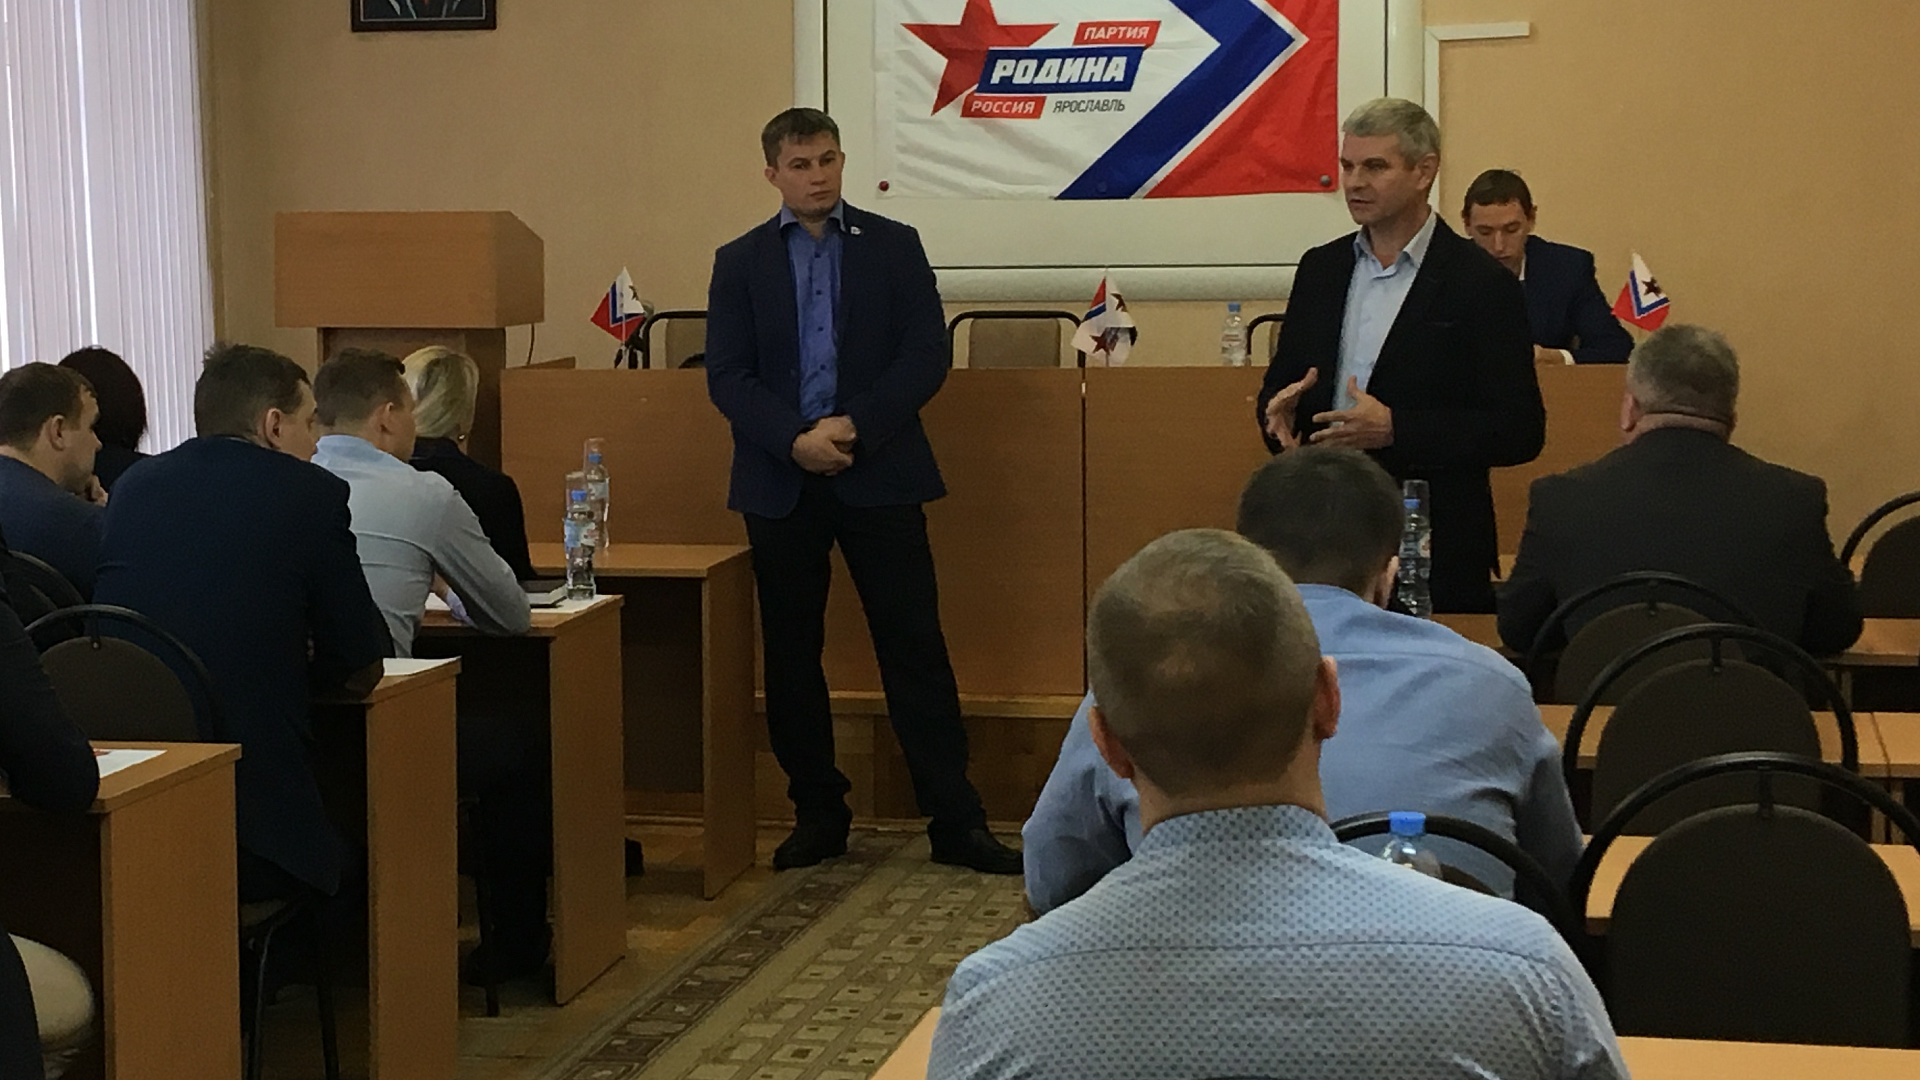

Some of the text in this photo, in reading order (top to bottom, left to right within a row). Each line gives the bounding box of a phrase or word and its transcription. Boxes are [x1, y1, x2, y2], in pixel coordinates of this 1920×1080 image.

[1083, 26, 1150, 40] ПАРТИЯ
[989, 56, 1128, 85] РОДИНА
[970, 101, 1036, 114] РОССИЯ
[1052, 99, 1126, 114] ЯРОСЛАВЛЬ
